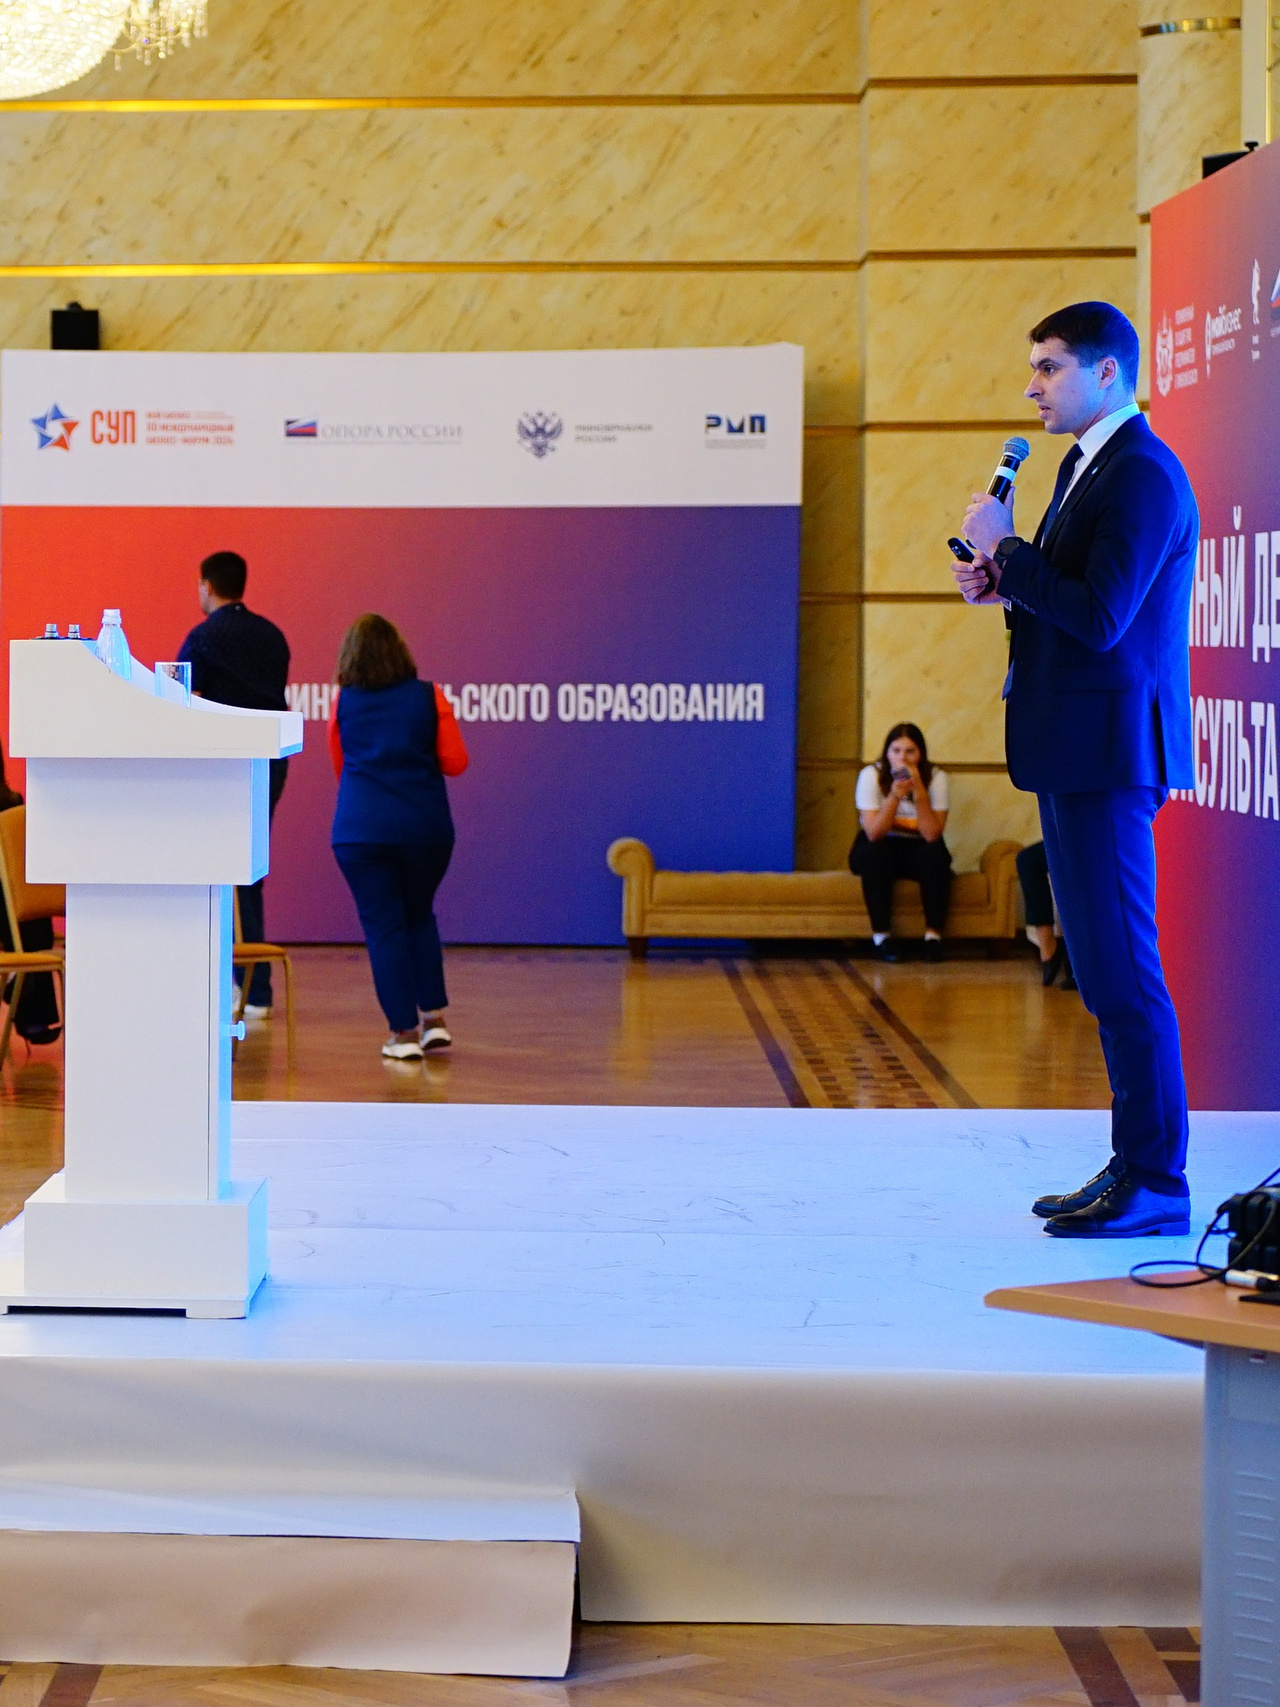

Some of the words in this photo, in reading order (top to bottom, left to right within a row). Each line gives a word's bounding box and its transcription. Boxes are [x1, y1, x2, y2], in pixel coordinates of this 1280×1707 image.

[91, 409, 136, 445] СУП
[322, 424, 384, 440] ОПОРА
[387, 424, 463, 440] РОССИИ
[558, 683, 765, 722] ОБРАЗОВАНИЯ
[1169, 695, 1280, 821] СУЛЬТА
